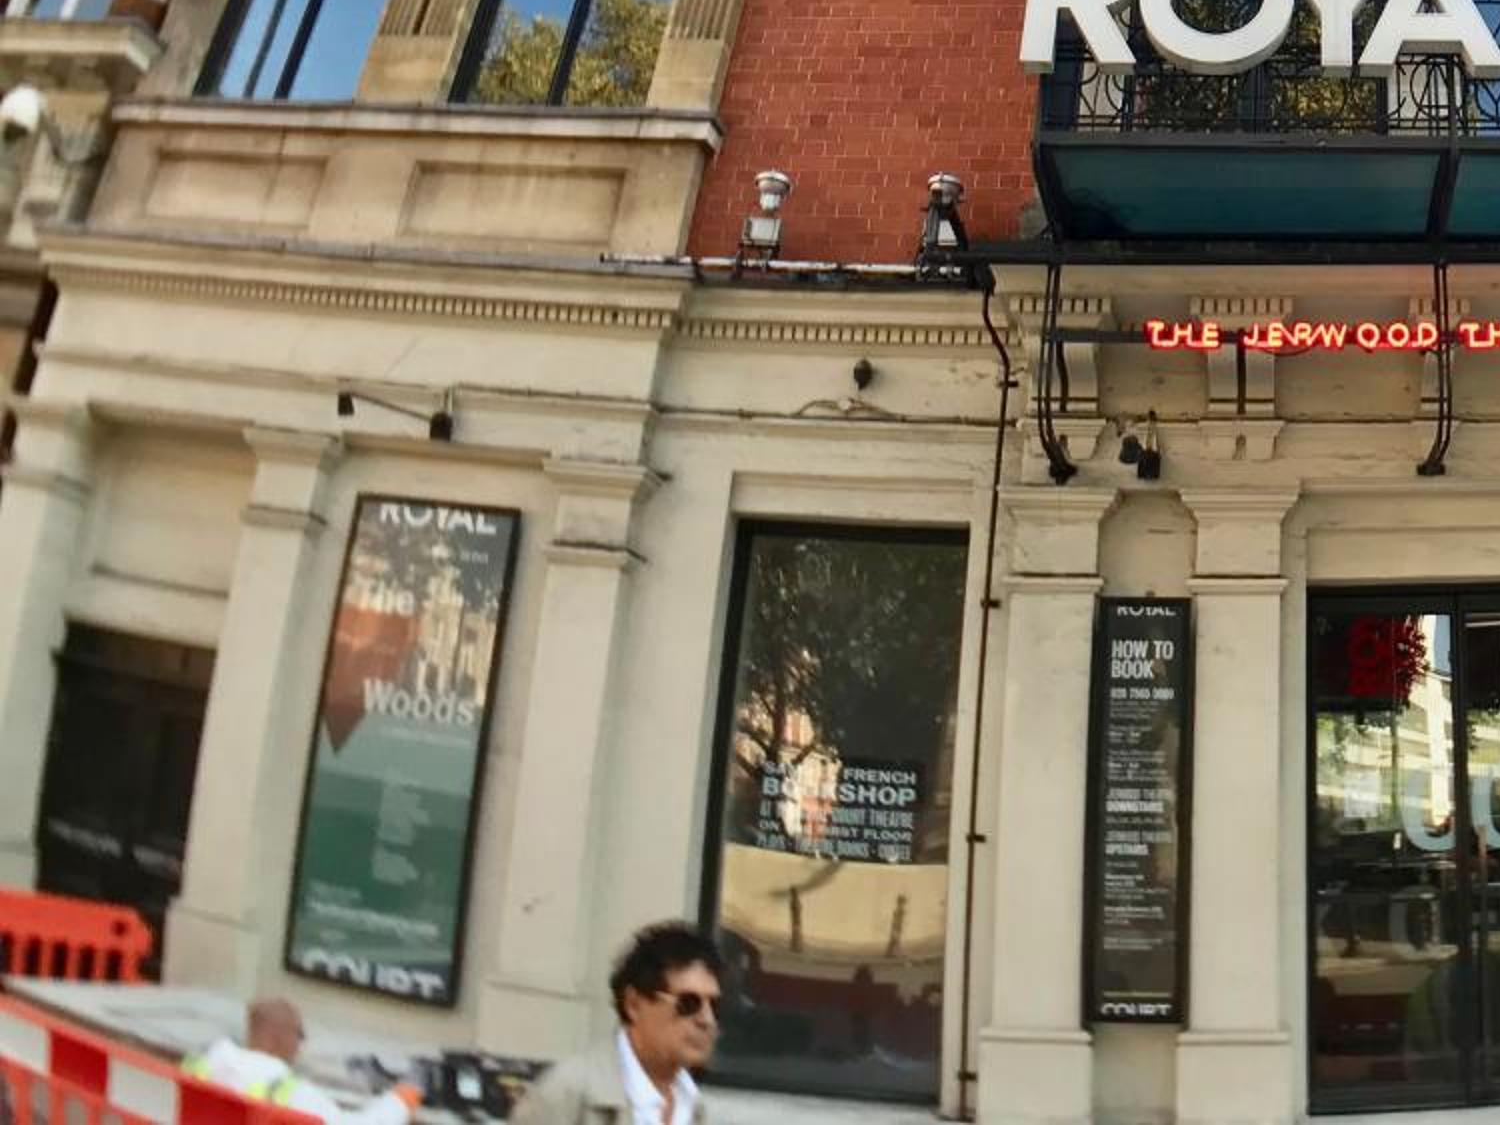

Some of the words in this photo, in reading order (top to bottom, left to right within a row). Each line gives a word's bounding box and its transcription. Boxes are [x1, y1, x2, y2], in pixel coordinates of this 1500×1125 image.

[1146, 319, 1221, 349] THE
[1242, 320, 1440, 351] JERWOOD
[1111, 639, 1150, 659] HOW
[1153, 639, 1175, 660] TO
[1110, 659, 1155, 680] BOOK
[364, 678, 475, 725] Woods
[843, 767, 917, 786] FRENCH
